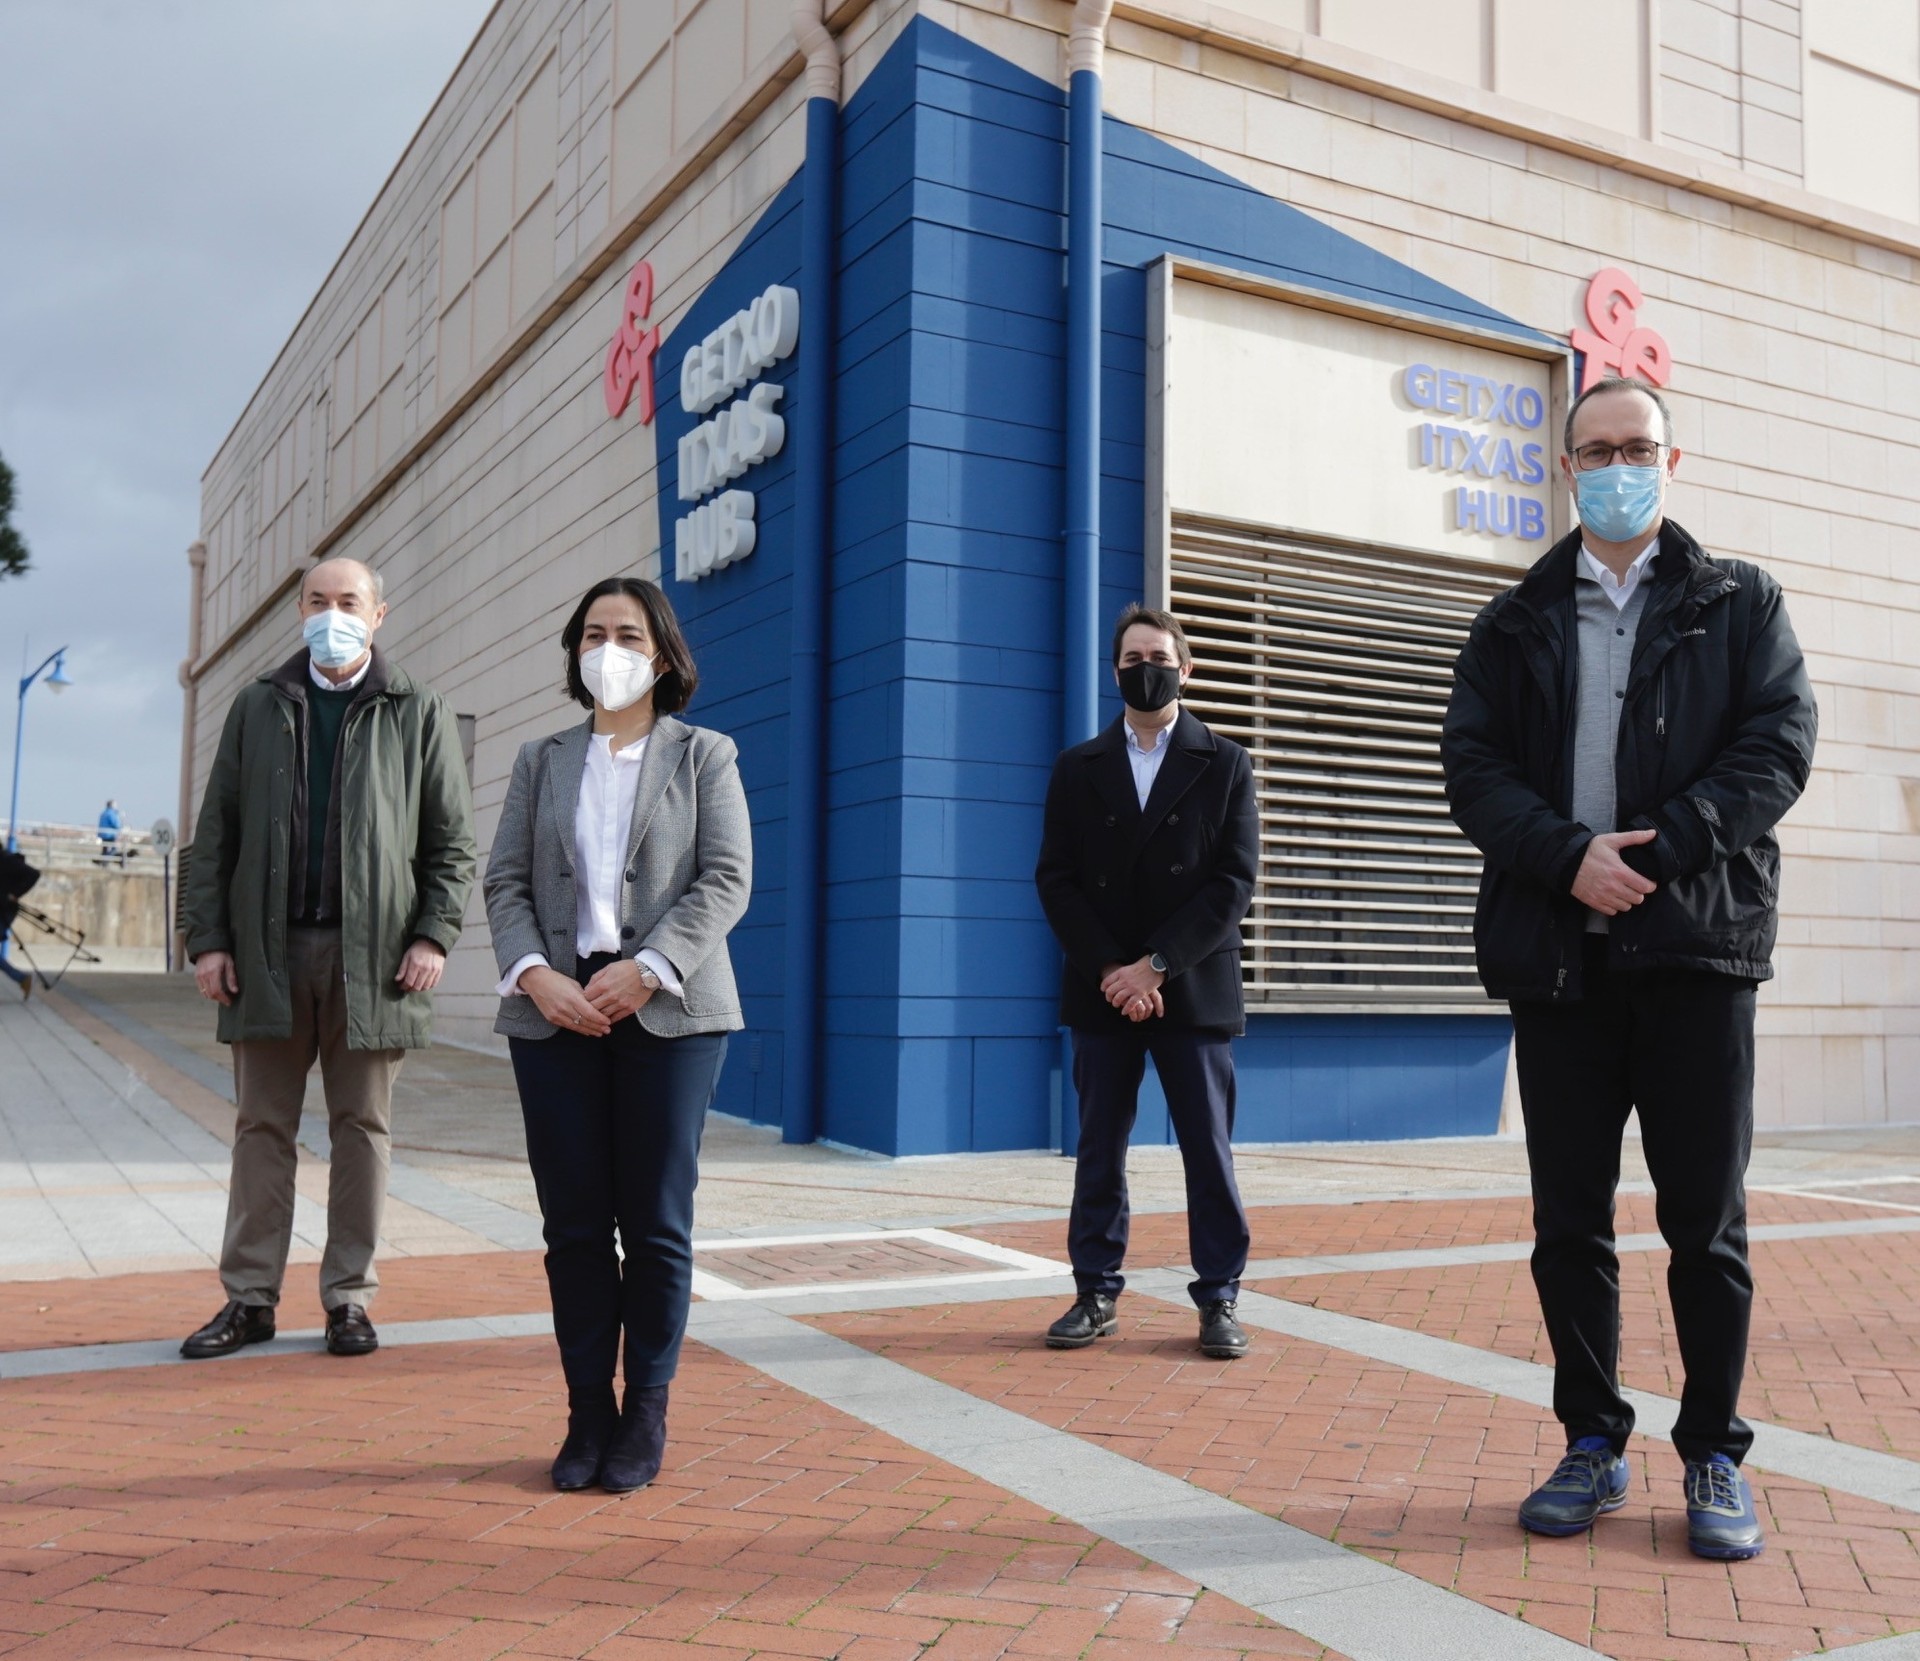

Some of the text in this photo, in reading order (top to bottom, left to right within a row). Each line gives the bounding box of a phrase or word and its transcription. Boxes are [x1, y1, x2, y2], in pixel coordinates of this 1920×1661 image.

[681, 284, 799, 413] GETXO
[1404, 363, 1543, 430] GETXO
[678, 382, 784, 500] ITXAS
[1420, 422, 1544, 485] ITXAS
[675, 489, 756, 582] HUB
[1456, 486, 1545, 541] HUB
